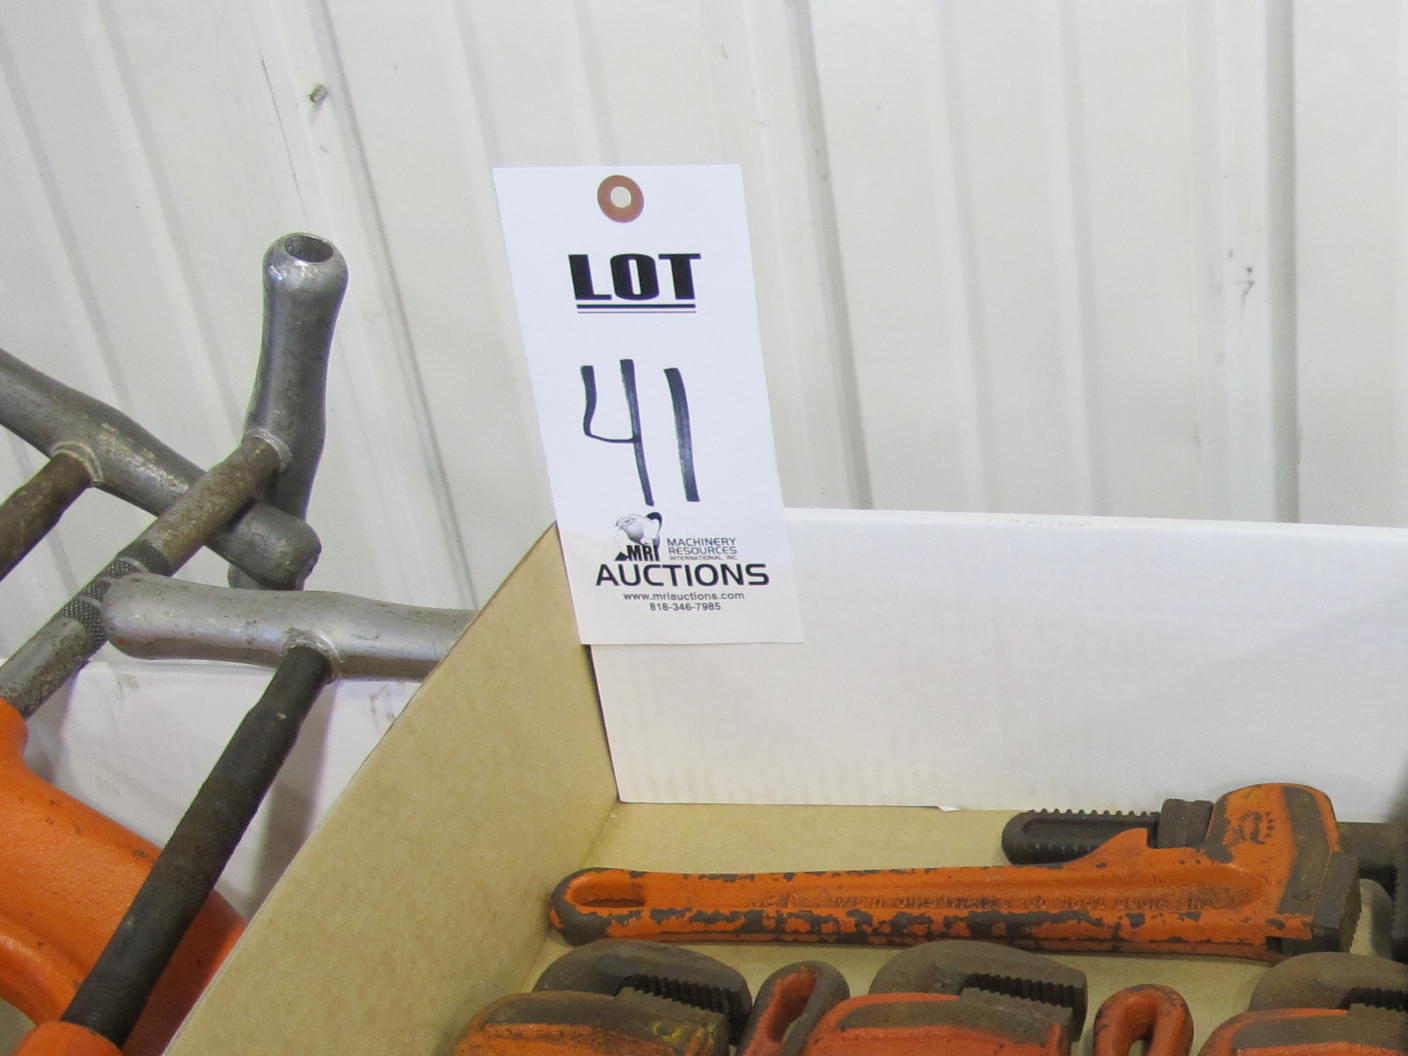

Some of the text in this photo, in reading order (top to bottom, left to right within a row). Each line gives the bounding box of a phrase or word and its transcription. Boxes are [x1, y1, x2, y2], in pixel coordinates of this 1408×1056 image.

[568, 253, 702, 301] LOT
[580, 358, 701, 507] 41
[666, 537, 736, 547] MACHINERY
[626, 543, 661, 562] MRI
[668, 546, 738, 555] RESOURCES
[595, 563, 770, 587] AUCTIONS
[623, 592, 745, 601] www.mriauctions.com
[650, 602, 722, 611] 818-346-7985
